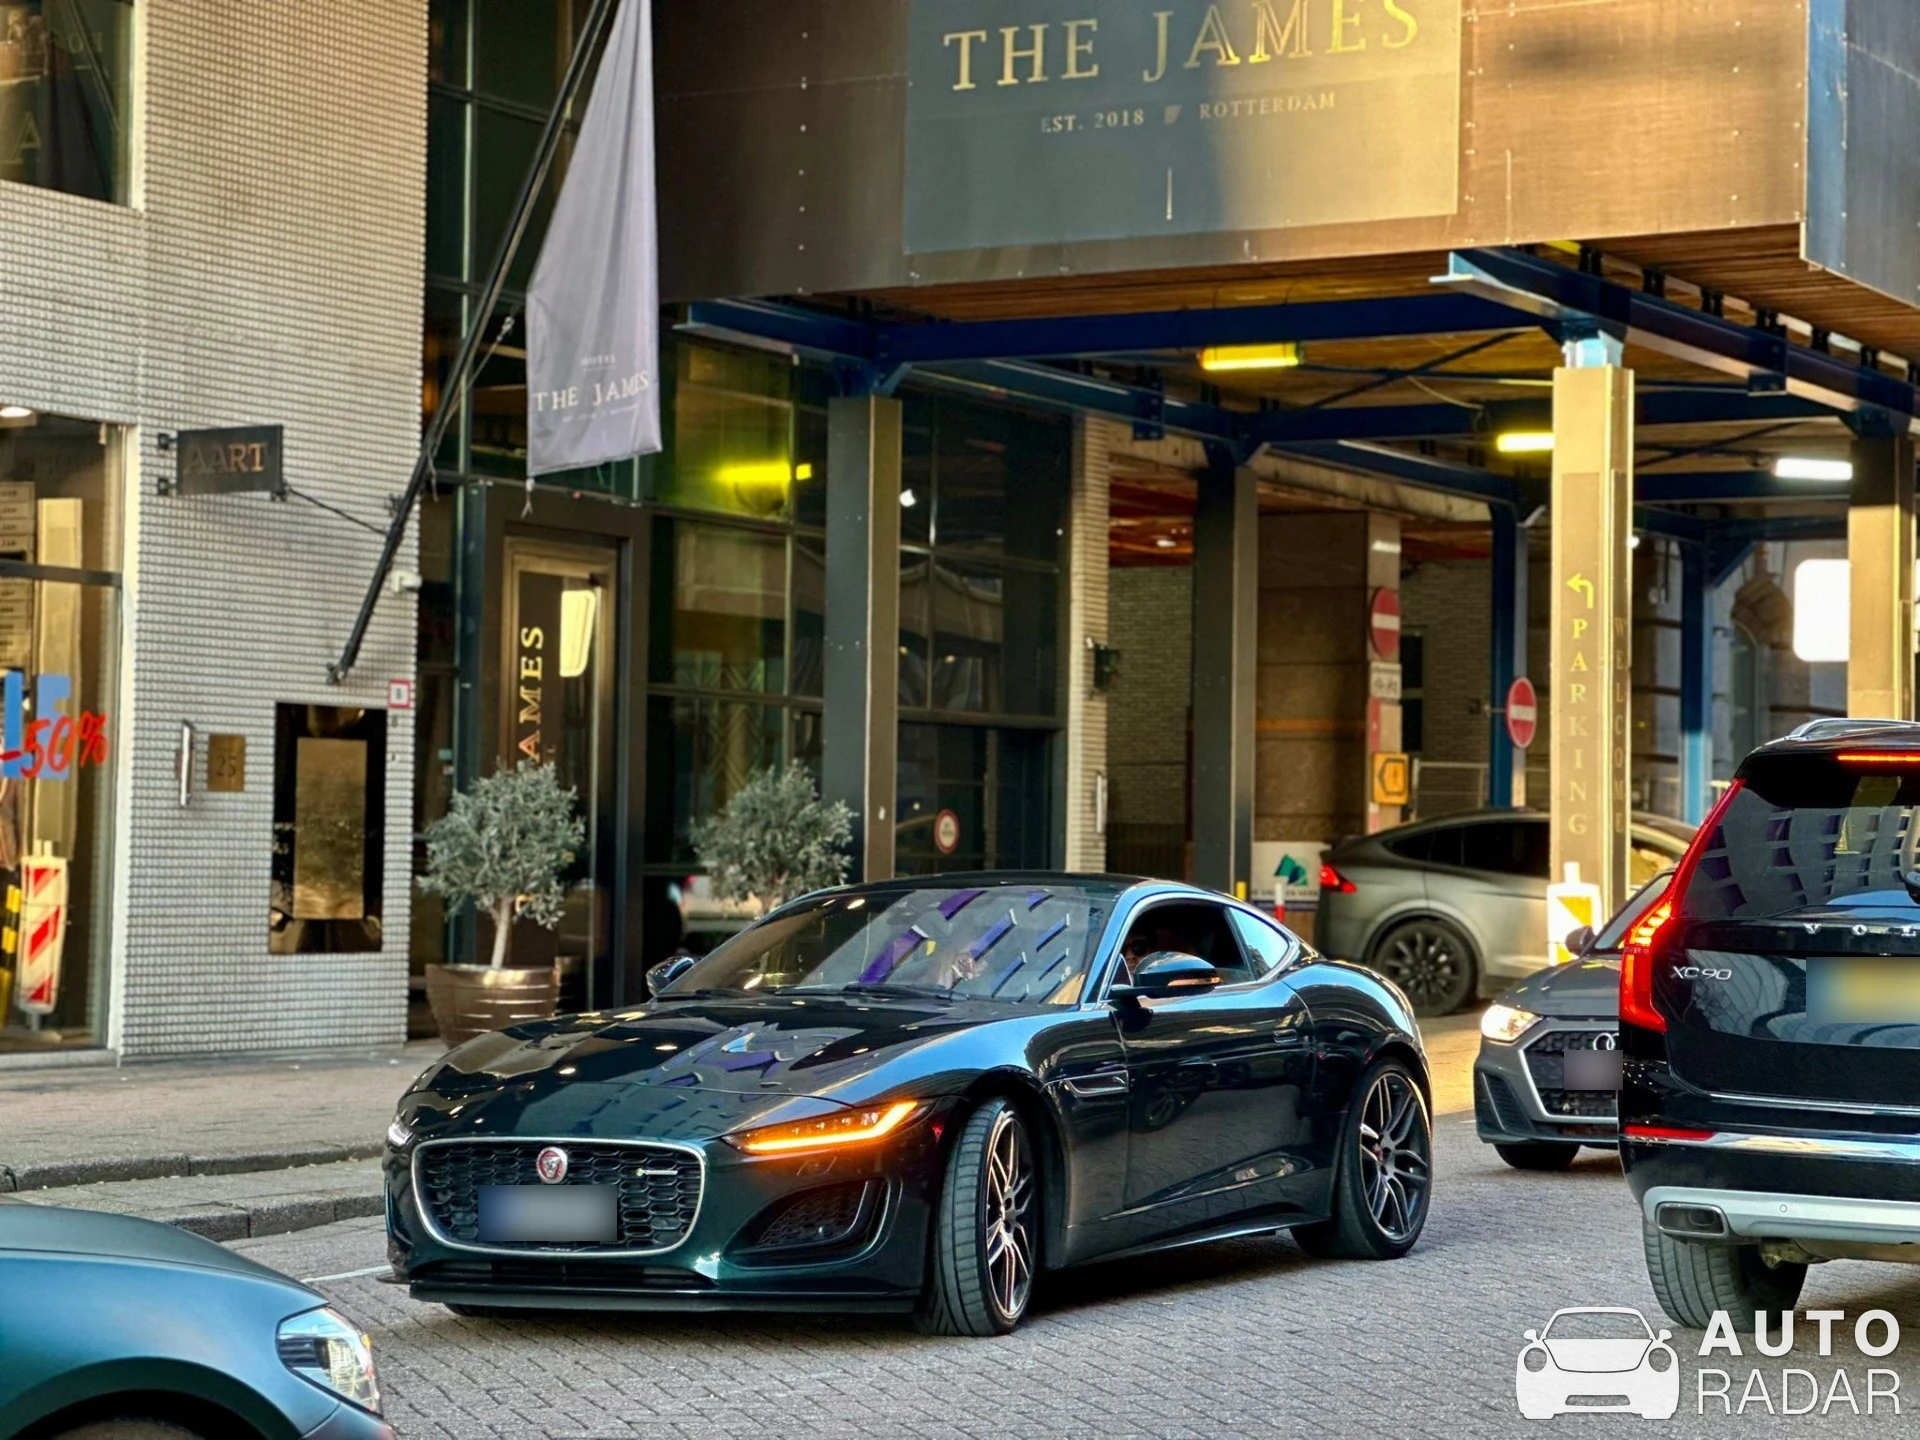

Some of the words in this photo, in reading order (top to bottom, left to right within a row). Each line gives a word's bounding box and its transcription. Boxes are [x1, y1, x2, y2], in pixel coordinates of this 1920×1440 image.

[943, 18, 1099, 91] THE
[1142, 0, 1418, 83] JAMES
[1040, 114, 1084, 133] EST.
[1094, 109, 1145, 129] 2018
[1200, 92, 1336, 119] ROTTERDAM
[534, 386, 579, 412] THE
[593, 370, 649, 406] JAMES
[184, 441, 268, 475] AART
[518, 626, 544, 763] AMES
[0, 710, 109, 779] -50%
[1567, 618, 1589, 835] PARKING
[1613, 616, 1627, 834] WELCOME
[215, 756, 237, 777] 25
[1670, 965, 1733, 981] XC90
